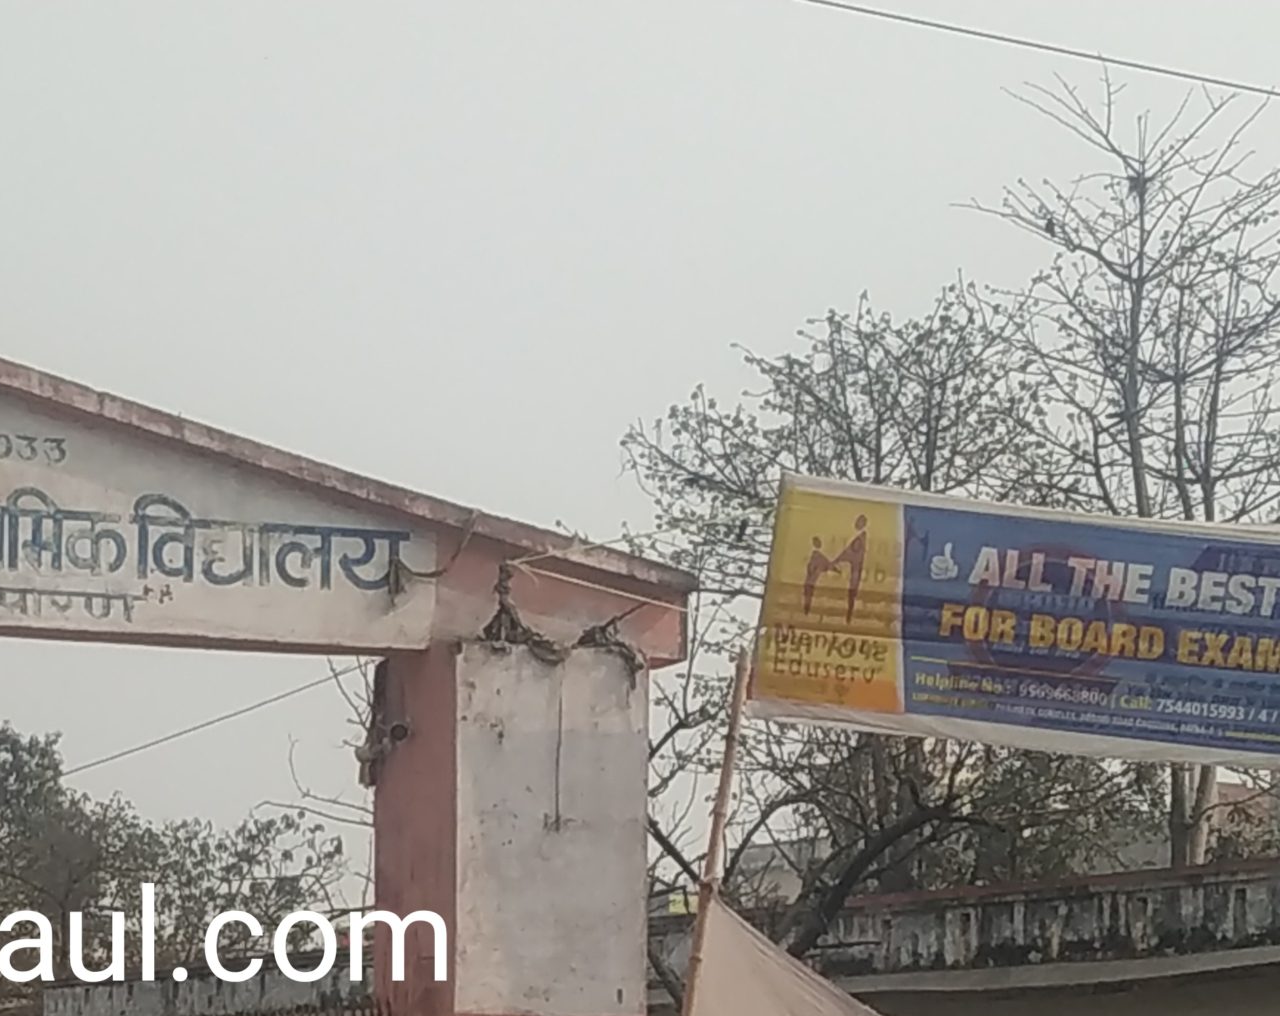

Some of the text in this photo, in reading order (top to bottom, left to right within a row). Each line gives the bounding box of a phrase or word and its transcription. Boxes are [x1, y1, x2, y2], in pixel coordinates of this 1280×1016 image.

[129, 493, 411, 591] विद्यालय
[968, 545, 1280, 617] ALL THE BEST
[939, 602, 1017, 645] FOR
[1029, 613, 1165, 661] BOARD
[1156, 698, 1245, 722] 7544015993
